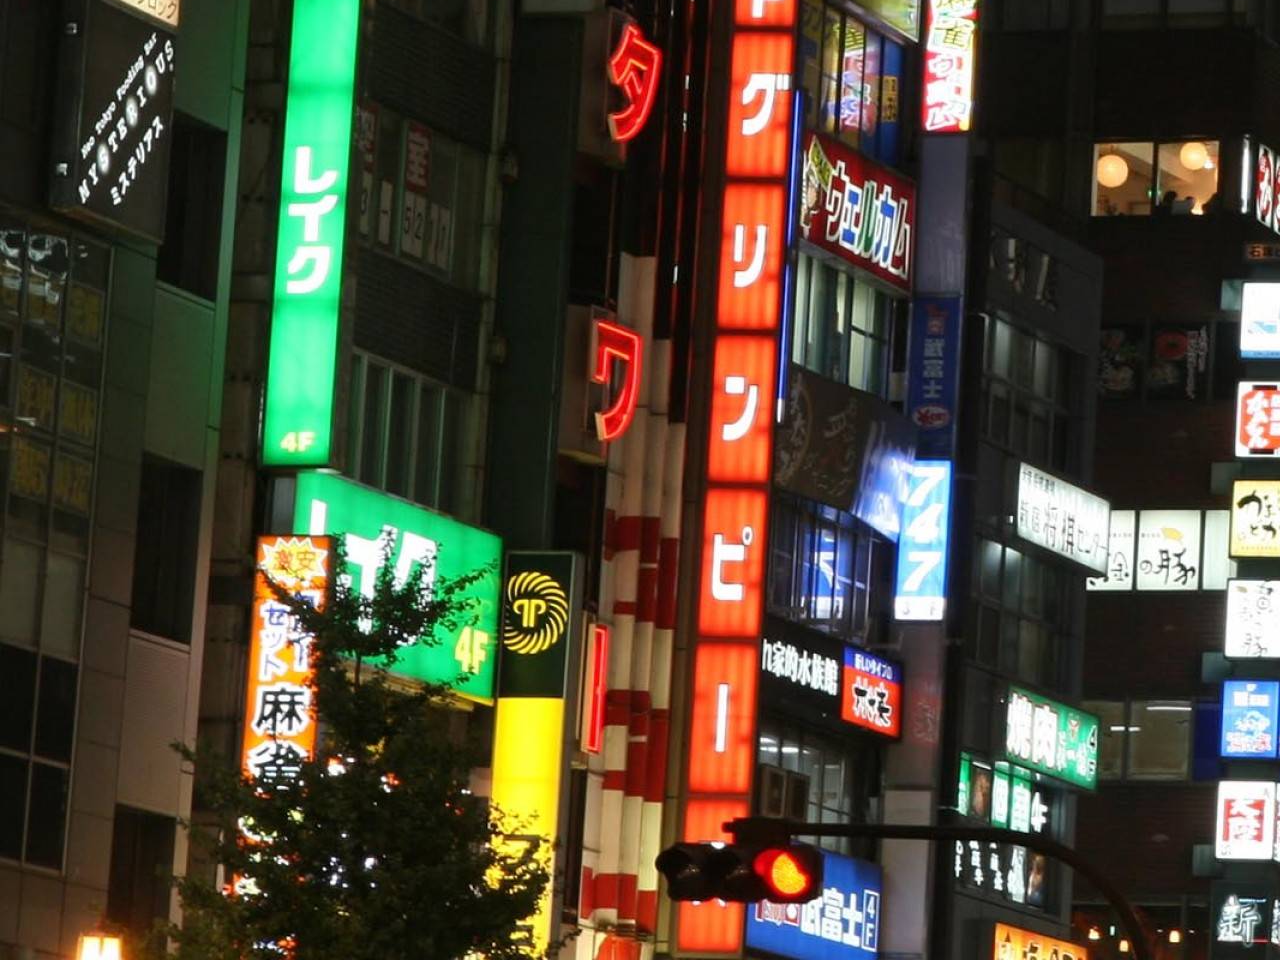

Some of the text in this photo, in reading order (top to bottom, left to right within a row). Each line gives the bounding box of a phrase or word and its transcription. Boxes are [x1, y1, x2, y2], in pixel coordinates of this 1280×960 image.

[286, 145, 339, 295] レイク
[902, 466, 948, 593] 747
[1088, 548, 1197, 587] 金の豚
[455, 625, 490, 673] 4F
